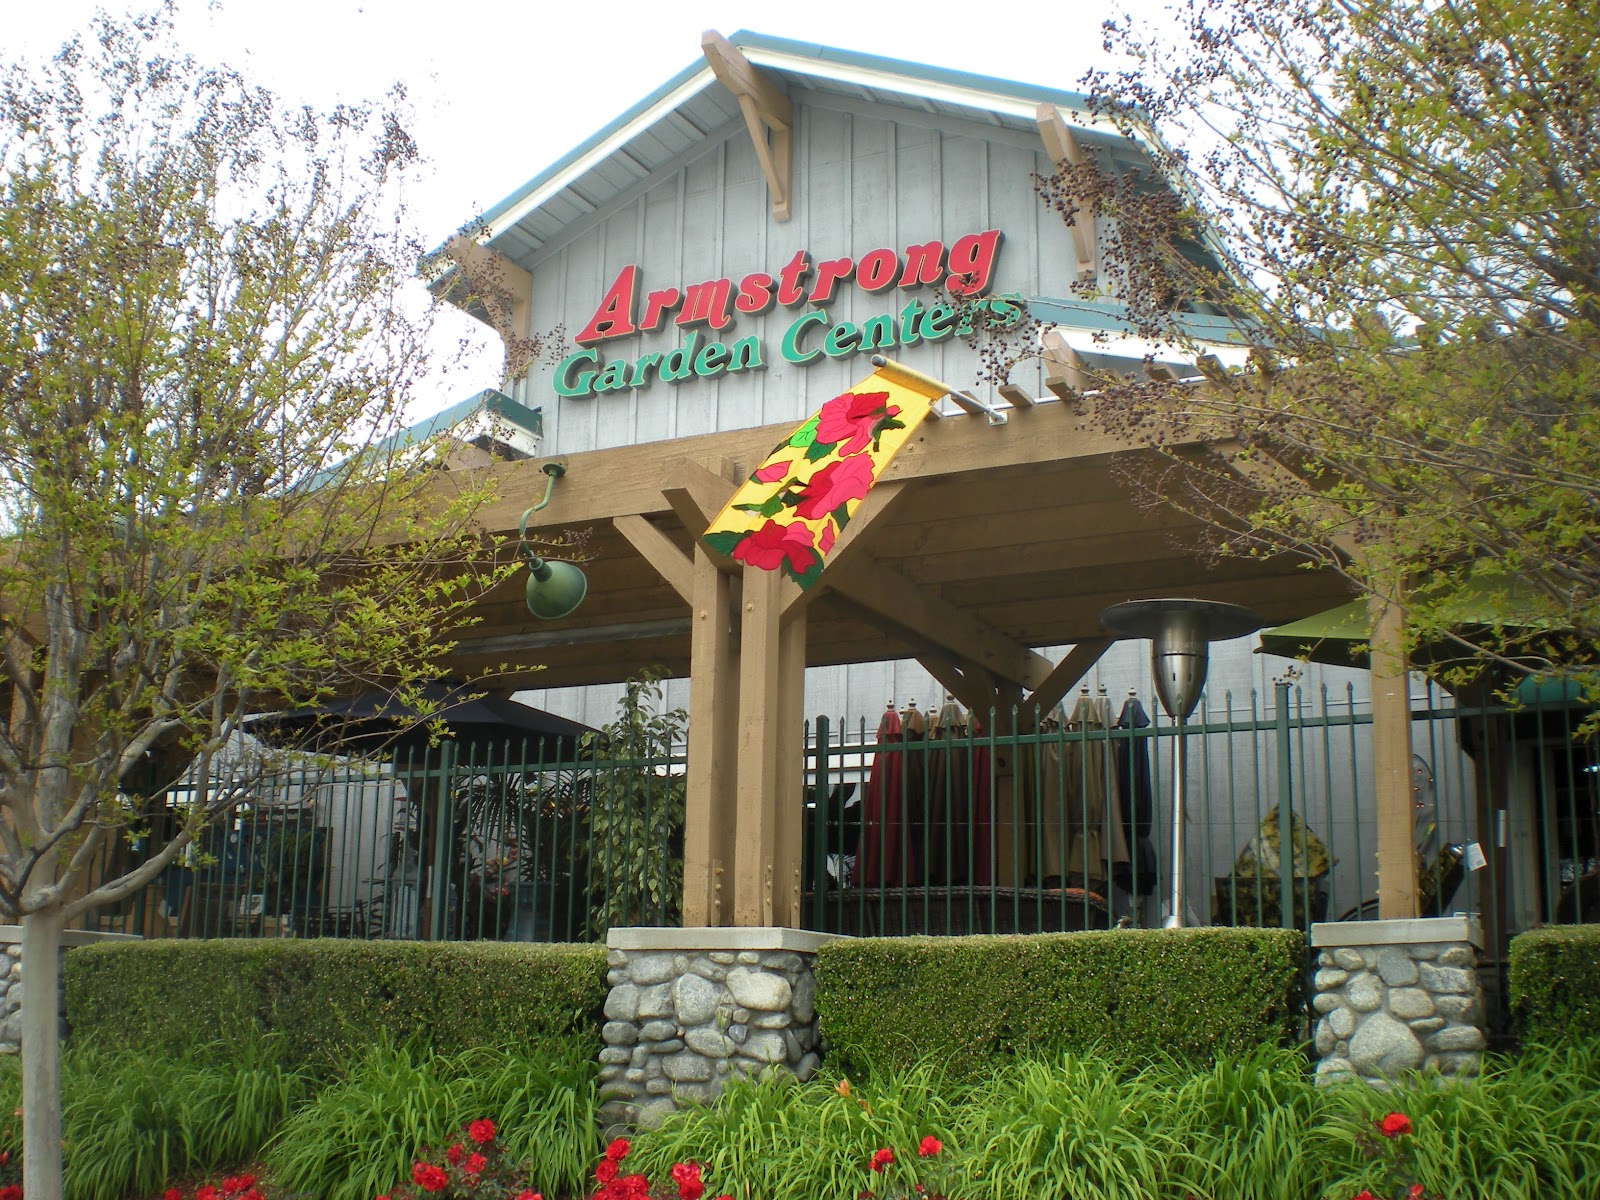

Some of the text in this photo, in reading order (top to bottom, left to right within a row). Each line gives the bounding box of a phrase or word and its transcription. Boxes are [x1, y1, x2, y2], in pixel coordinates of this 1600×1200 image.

[575, 228, 1004, 344] Armstrong
[552, 291, 1024, 398] Garden Centers
